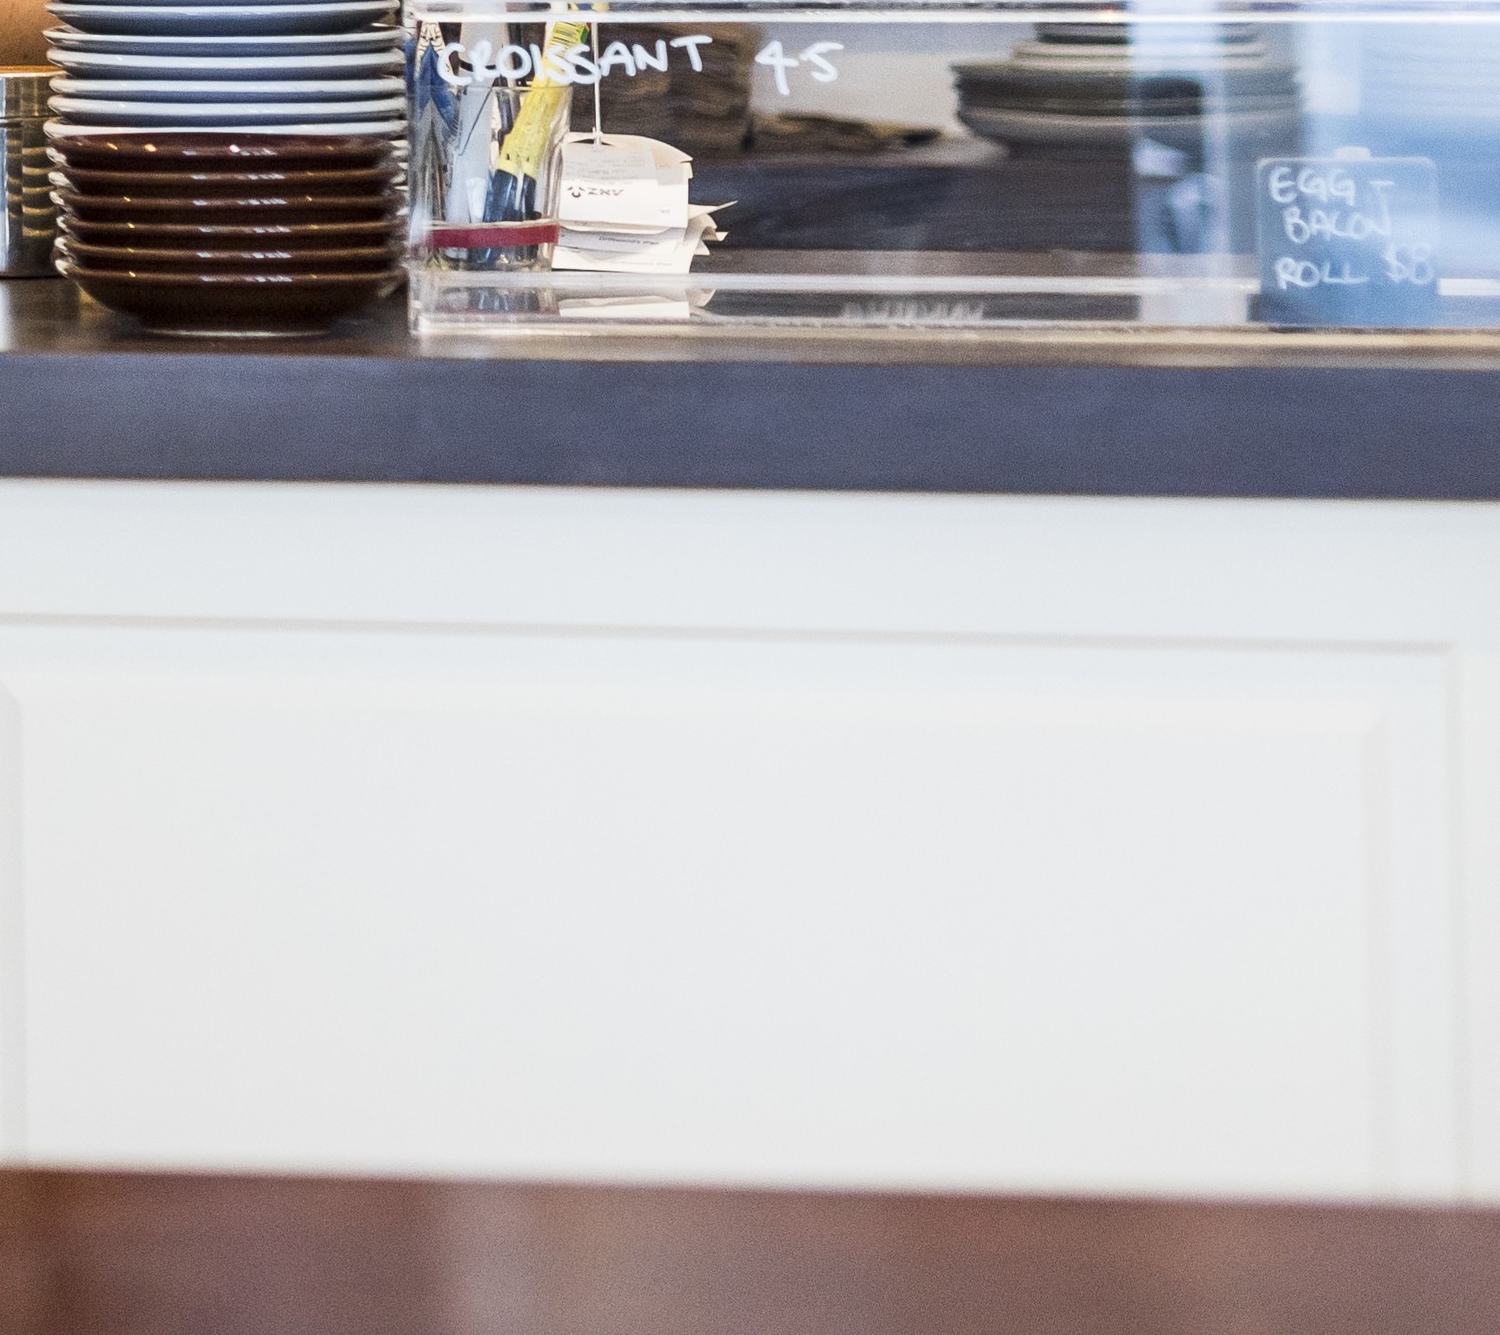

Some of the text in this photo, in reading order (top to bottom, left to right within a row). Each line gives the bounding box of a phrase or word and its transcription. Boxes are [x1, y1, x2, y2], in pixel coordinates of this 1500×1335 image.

[437, 35, 712, 85] CROISSANT
[1268, 166, 1356, 207] EGG
[1282, 189, 1392, 244] BACON
[1274, 256, 1370, 290] ROLL
